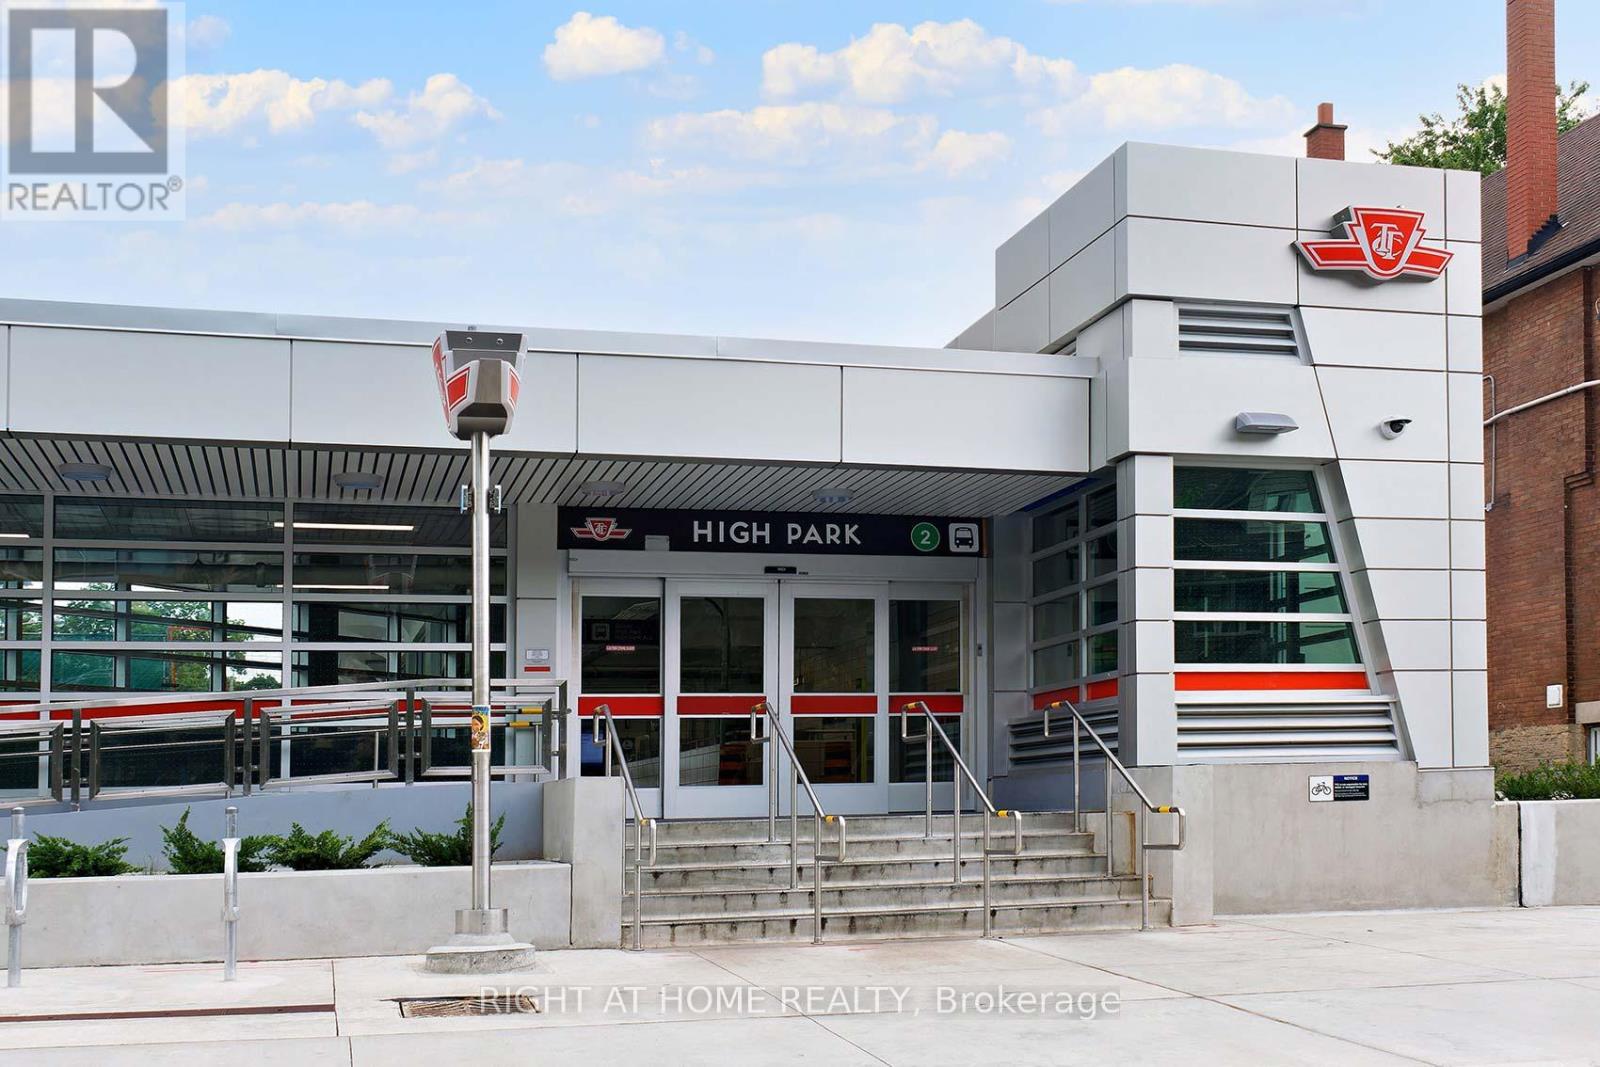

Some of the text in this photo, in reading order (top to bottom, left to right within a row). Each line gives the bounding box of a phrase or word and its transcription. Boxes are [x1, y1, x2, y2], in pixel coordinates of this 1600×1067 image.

[693, 520, 862, 545] HIGH PARK
[920, 530, 931, 545] 2
